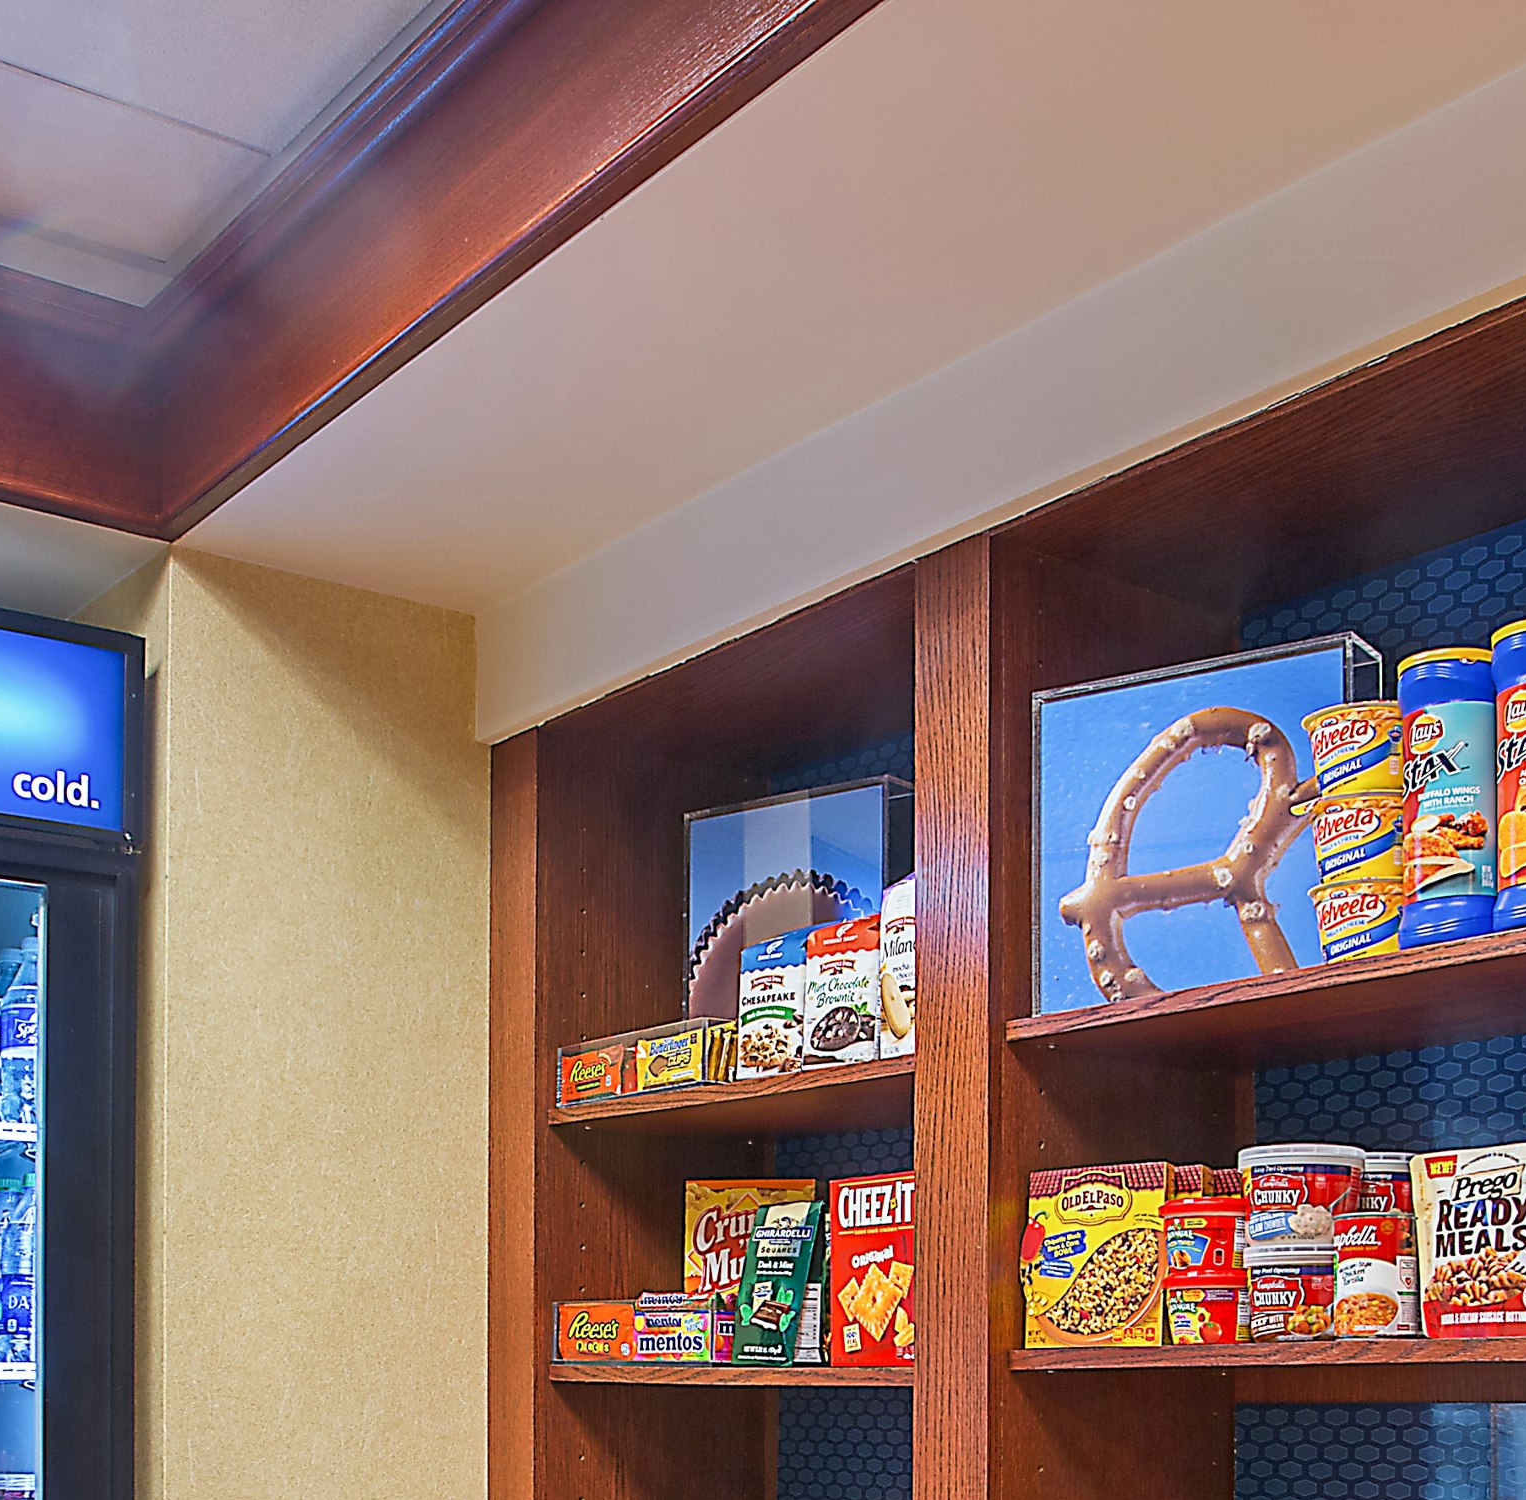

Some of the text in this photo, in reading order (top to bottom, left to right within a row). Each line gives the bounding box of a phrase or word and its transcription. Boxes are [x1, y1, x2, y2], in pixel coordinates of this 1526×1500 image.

[13, 769, 100, 809] cold.
[1452, 786, 1480, 795] WINGS
[1444, 795, 1473, 804] RANCH
[1330, 932, 1371, 955] ORIGINAL
[741, 991, 795, 1006] CHESAPEAKE
[570, 1060, 606, 1081] Reese's
[1429, 1161, 1454, 1174] NEW!
[1454, 1172, 1517, 1200] Prego
[838, 1181, 915, 1228] CHEEZ-IT
[1062, 1195, 1081, 1209] OLD
[1095, 1190, 1123, 1207] PASO
[1255, 1190, 1300, 1205] CHUNKY
[755, 1226, 812, 1240] GHIRARDELLI
[761, 1246, 797, 1255] SQUARES
[1254, 1291, 1296, 1307] CHUNKY
[568, 1312, 620, 1339] Reese's
[638, 1332, 703, 1352] mentos
